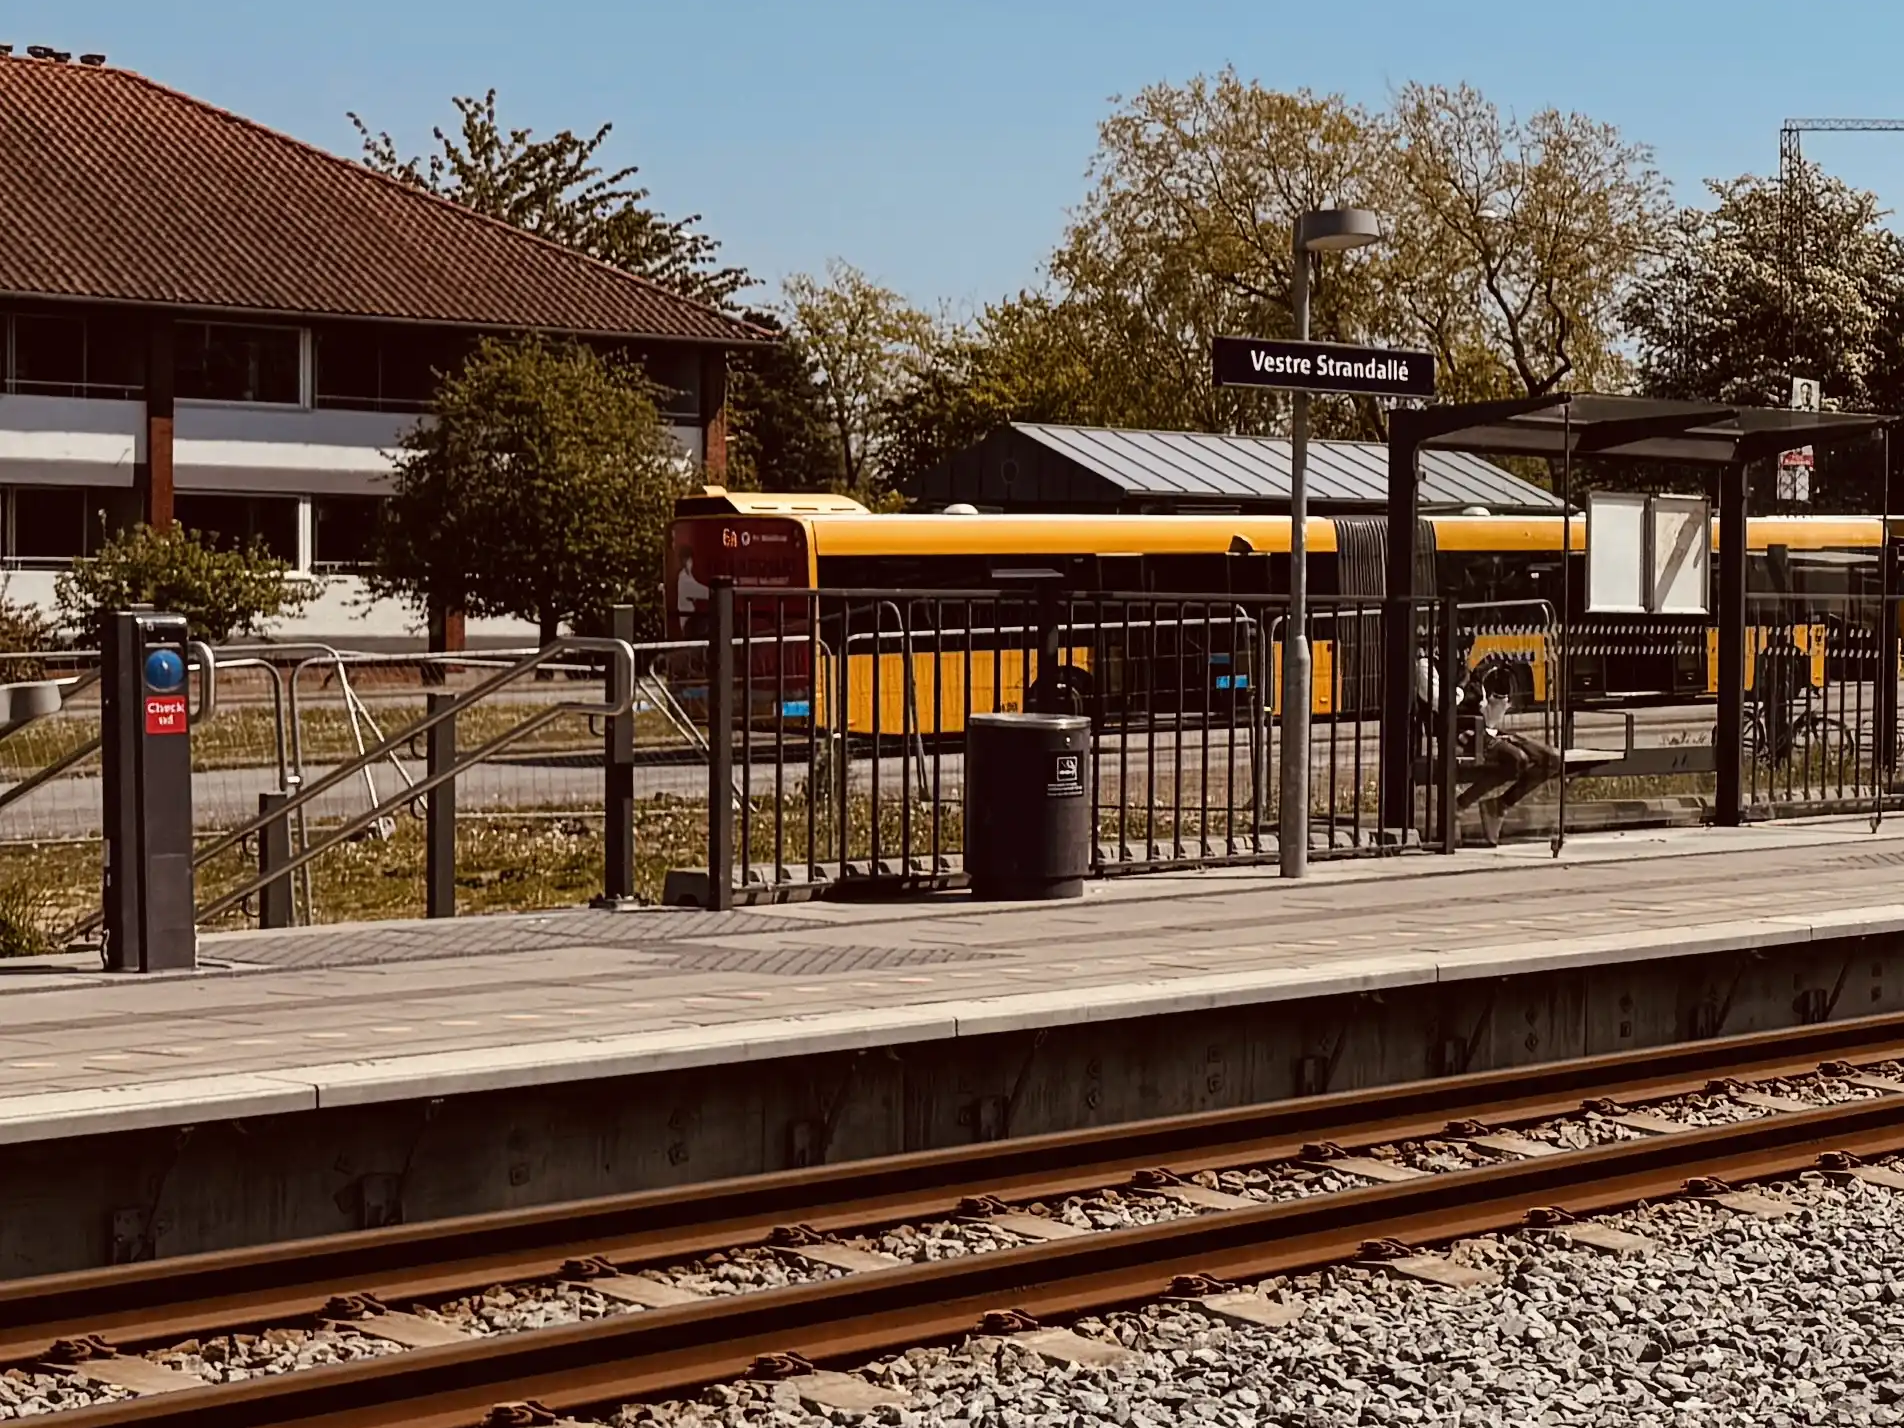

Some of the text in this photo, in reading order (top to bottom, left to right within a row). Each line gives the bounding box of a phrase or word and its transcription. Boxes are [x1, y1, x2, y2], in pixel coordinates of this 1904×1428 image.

[1250, 349, 1409, 381] Vestre Strandallé
[147, 701, 185, 714] Check
